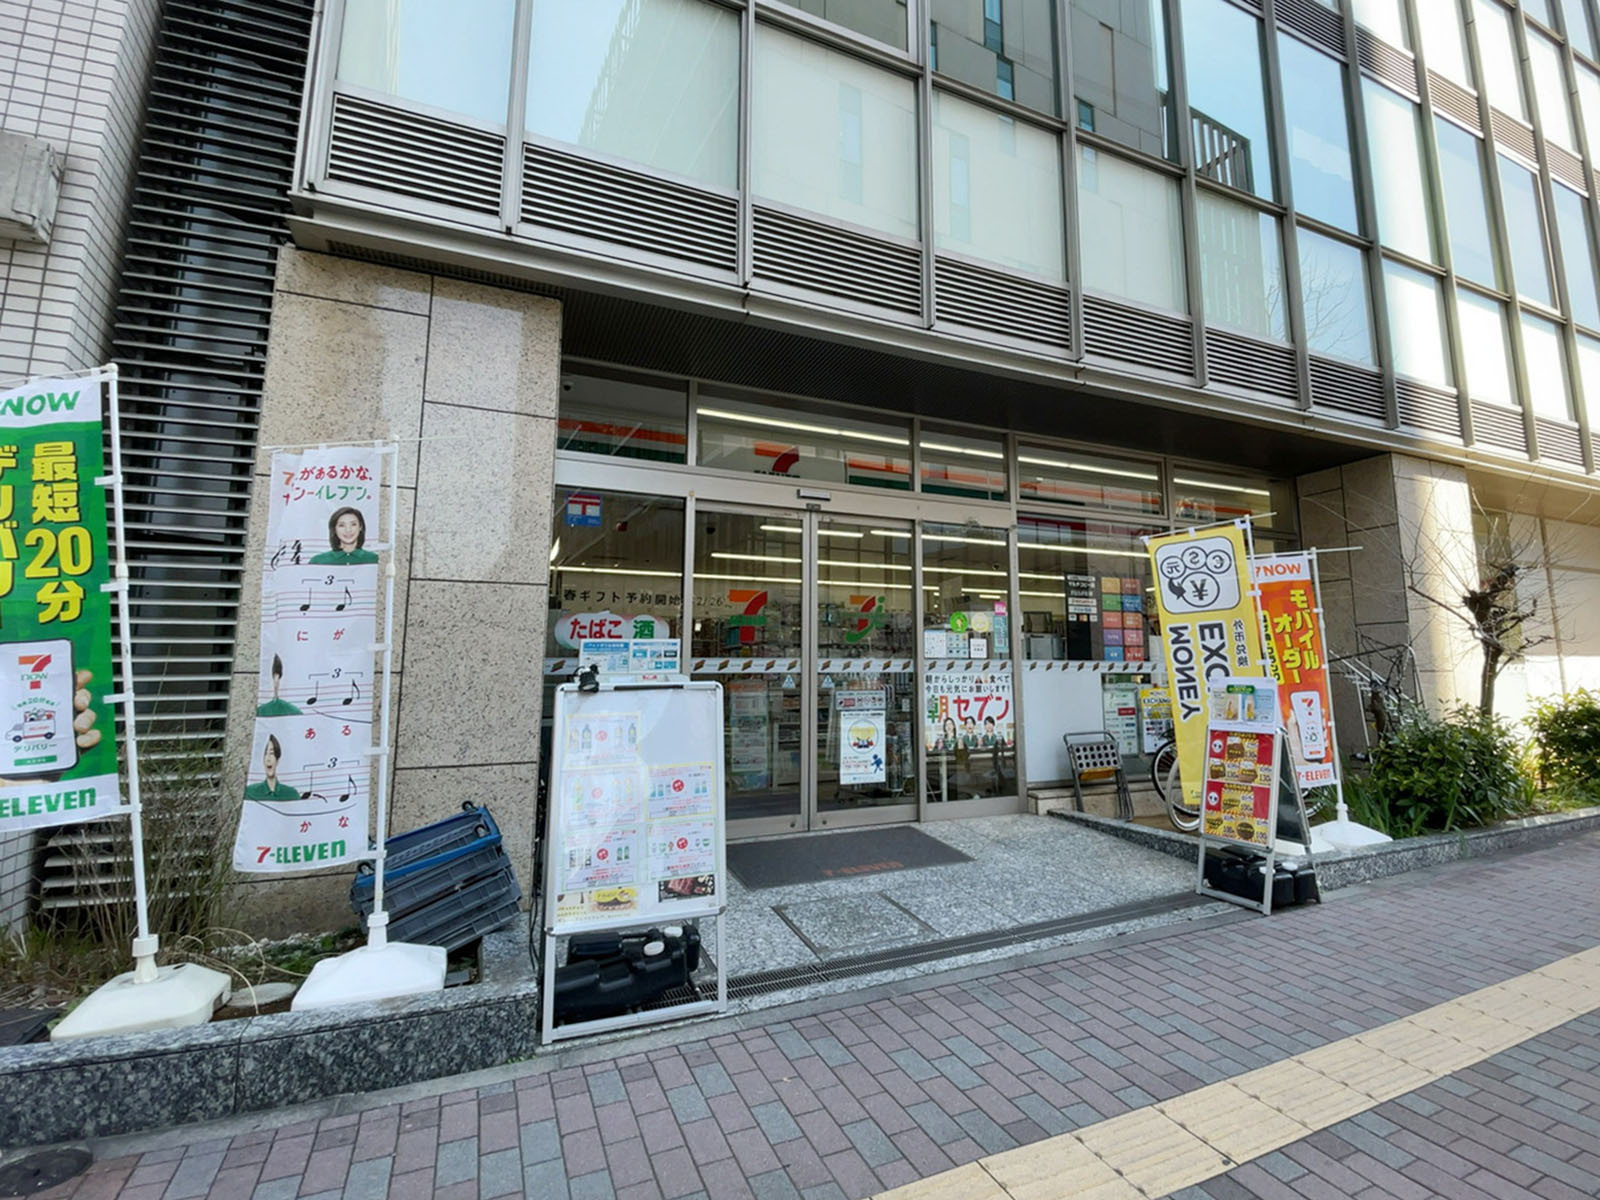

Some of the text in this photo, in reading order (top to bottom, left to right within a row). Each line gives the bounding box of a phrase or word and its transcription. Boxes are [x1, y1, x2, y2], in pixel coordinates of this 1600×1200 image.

[24, 441, 93, 624] 最短20分
[333, 628, 345, 641] が
[569, 618, 655, 640] たばこ 酒
[1290, 589, 1320, 670] モバイル
[1273, 613, 1302, 683] オーダー
[927, 693, 1010, 724] 朝セブン
[305, 725, 351, 740] あ る
[300, 815, 350, 833] か な
